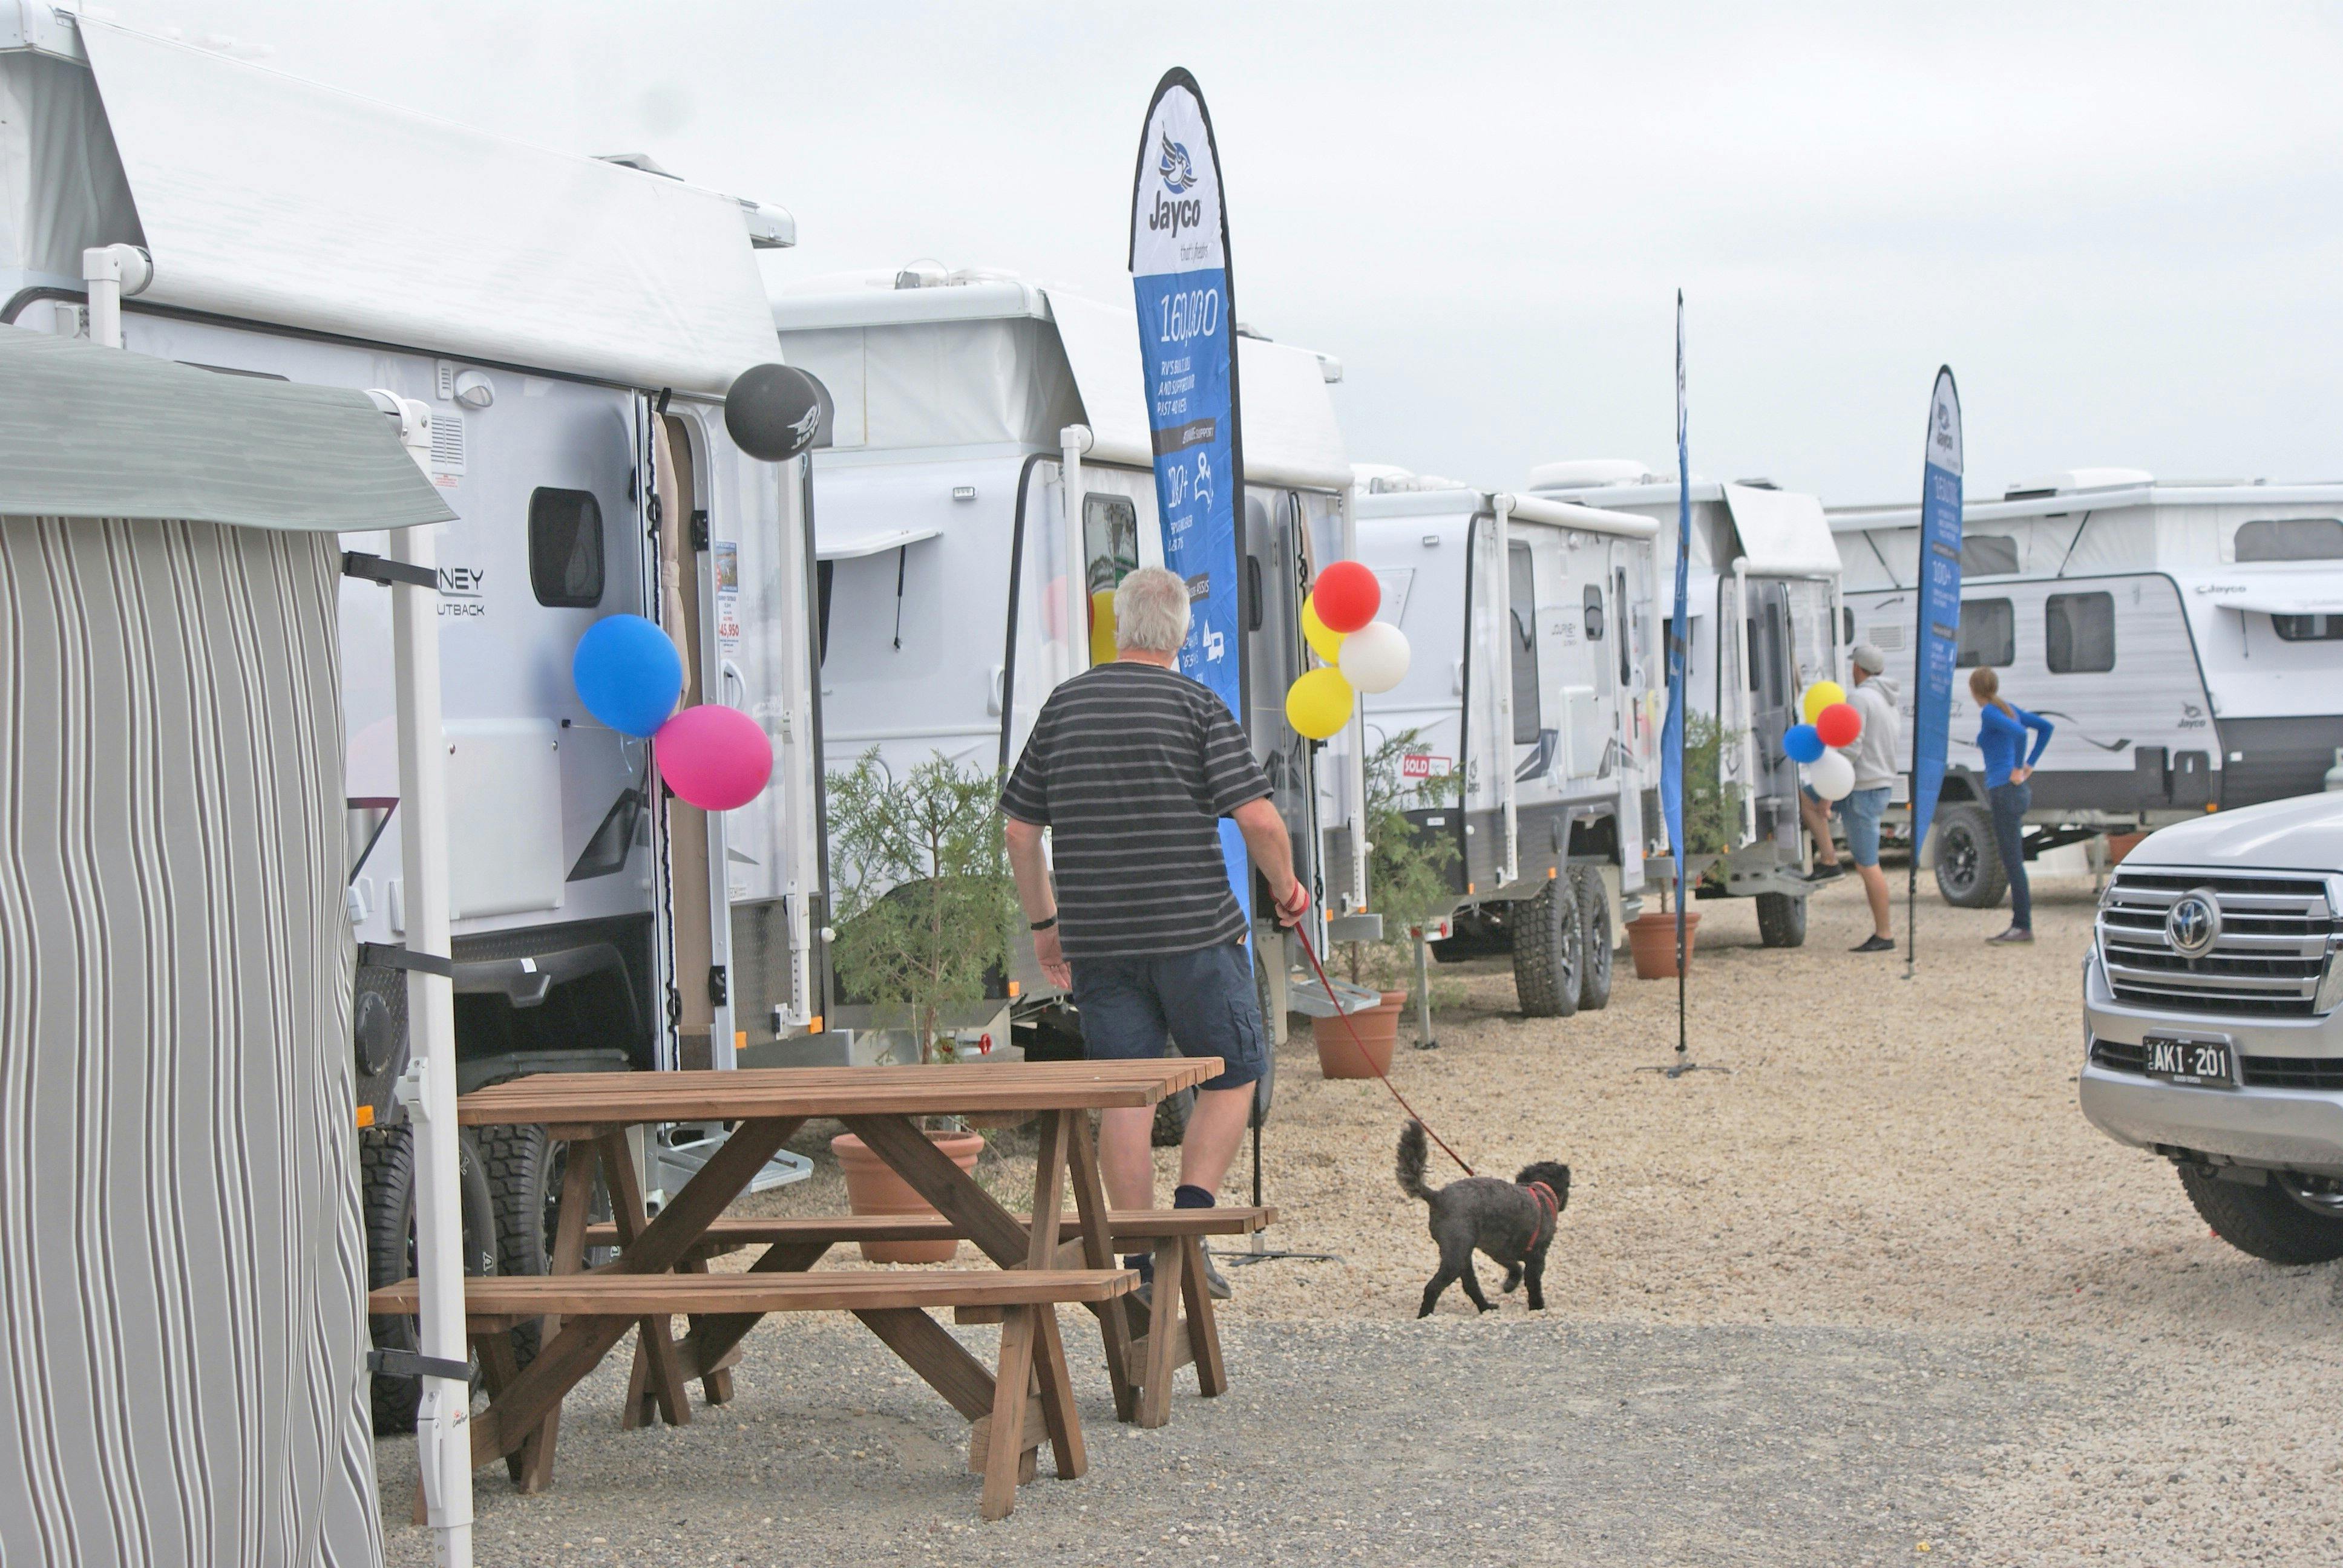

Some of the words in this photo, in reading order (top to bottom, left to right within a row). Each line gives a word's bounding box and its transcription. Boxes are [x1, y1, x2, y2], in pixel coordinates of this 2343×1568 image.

[1149, 190, 1202, 238] Jayco
[1196, 580, 1210, 594] ASSIS
[2207, 585, 2247, 595] Jayco
[437, 603, 485, 616] UTBACK
[2177, 718, 2206, 729] Jayco
[1404, 759, 1428, 774] SOLD
